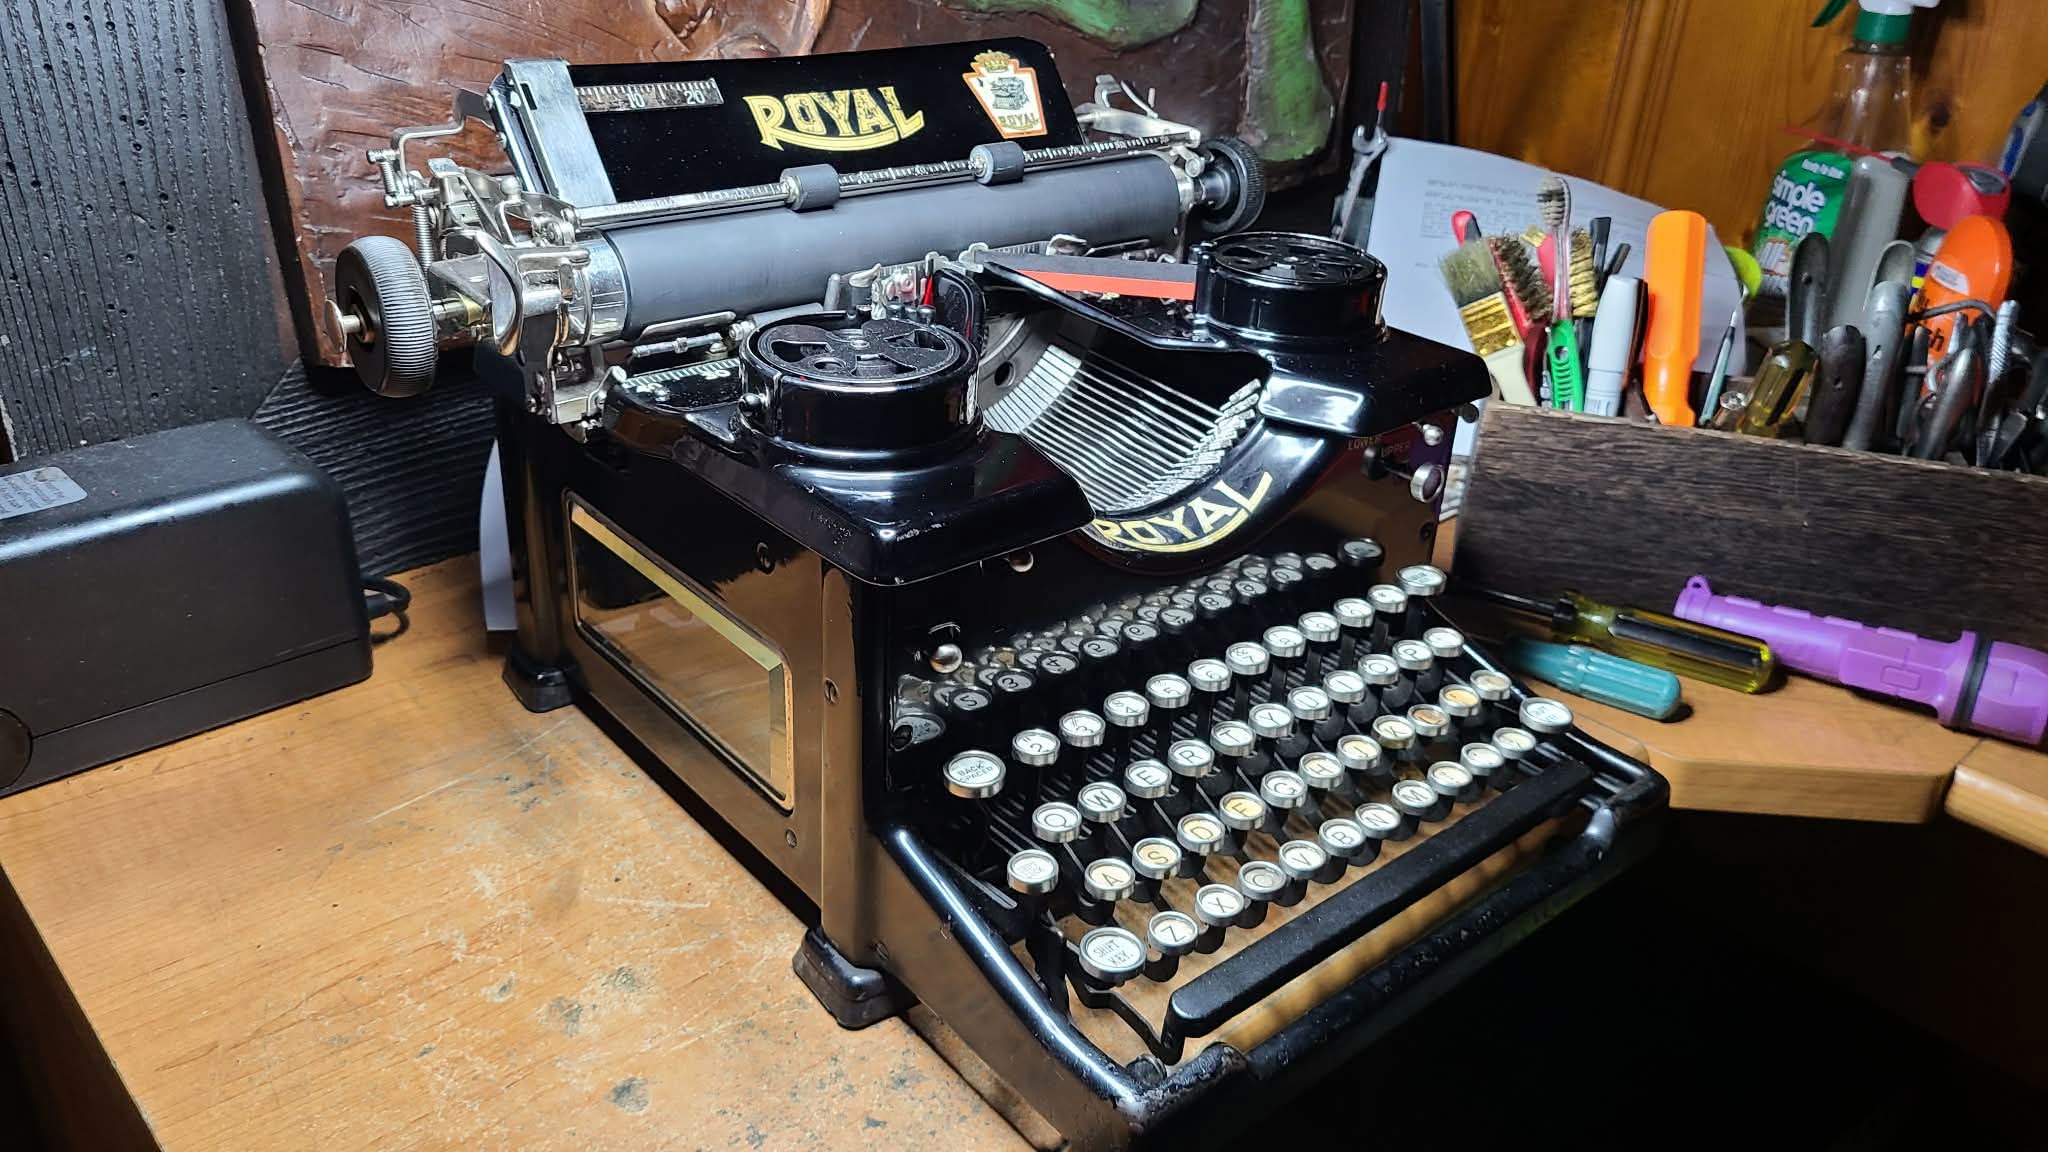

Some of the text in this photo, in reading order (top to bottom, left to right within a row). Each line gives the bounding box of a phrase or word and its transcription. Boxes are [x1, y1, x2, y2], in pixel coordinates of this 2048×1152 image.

[627, 89, 706, 108] 10 20
[742, 86, 925, 151] ROYAL
[998, 113, 1039, 130] ROYAL
[1772, 169, 1826, 214] simple
[1764, 201, 1814, 239] green
[1091, 471, 1273, 552] ROYAL
[1403, 648, 1420, 660] P
[1369, 663, 1387, 674] O
[1302, 694, 1320, 708] U
[1259, 711, 1281, 726] Y
[1219, 729, 1241, 743] T
[1384, 725, 1408, 738] K
[1179, 749, 1203, 764] R
[959, 760, 985, 777] BACK
[1309, 763, 1334, 776] H
[1136, 768, 1160, 785] E
[1274, 782, 1297, 796] G
[1403, 789, 1426, 802] M
[1087, 790, 1115, 809] W
[1232, 803, 1254, 818] F
[1045, 813, 1073, 828] Q
[1365, 812, 1389, 827] N
[1190, 826, 1214, 840] D
[1332, 831, 1355, 845] B
[1147, 851, 1169, 865] S
[1291, 854, 1312, 867] V
[1101, 873, 1124, 887] A
[1251, 873, 1274, 888] C
[1208, 897, 1235, 913] X
[1161, 925, 1187, 943] Z
[1092, 939, 1121, 958] SHIFT
